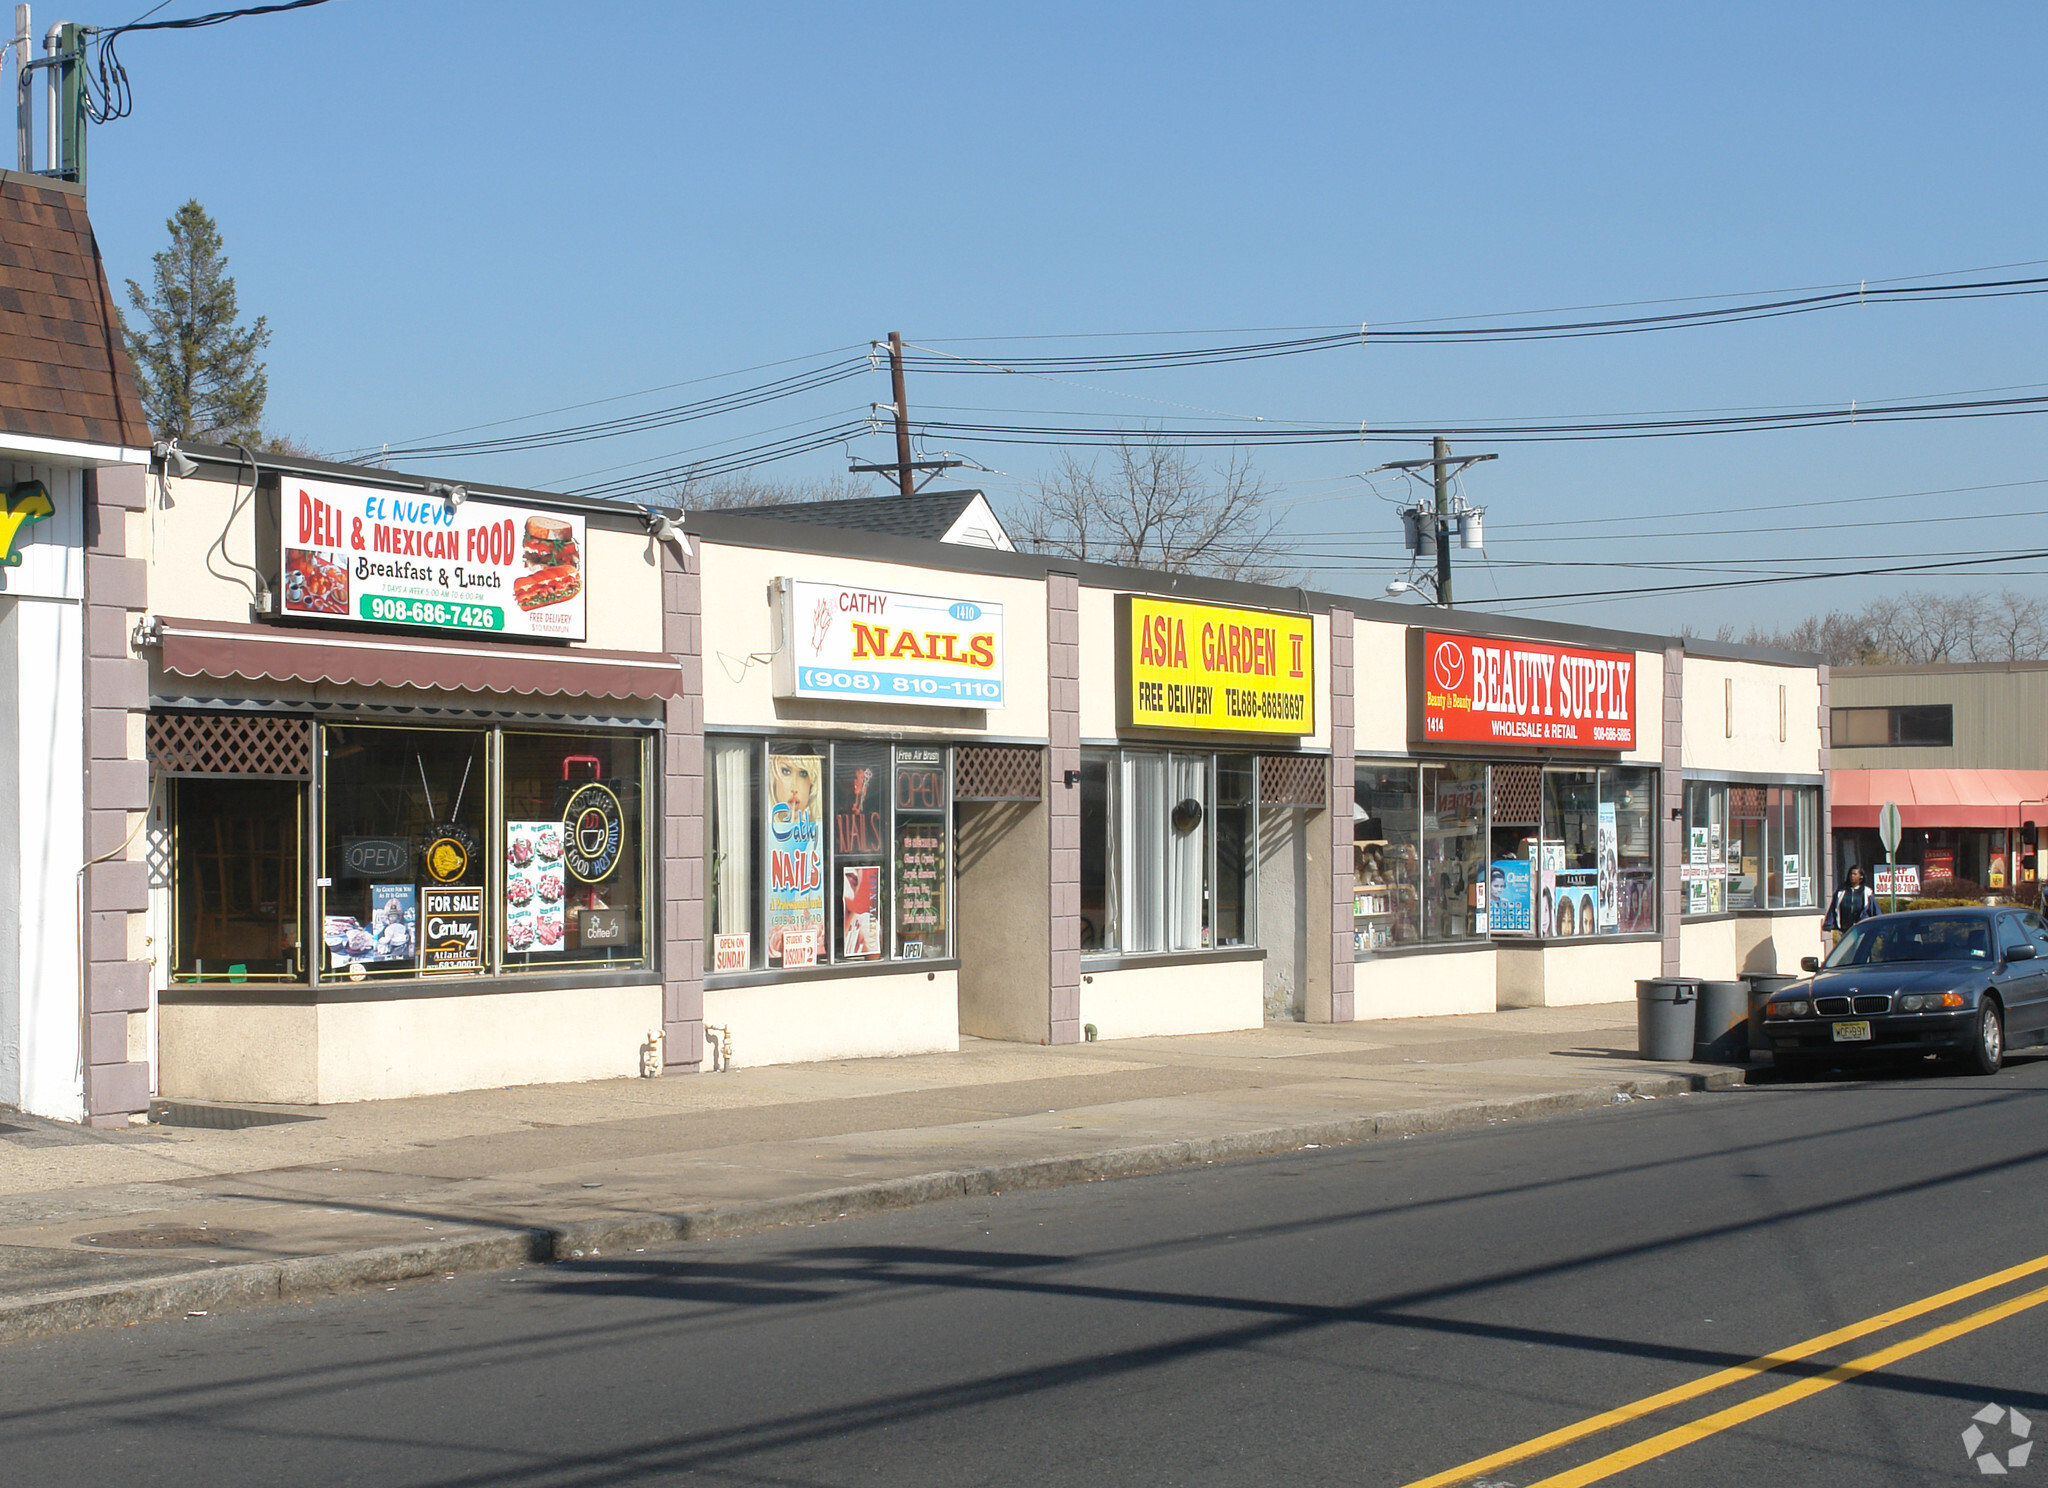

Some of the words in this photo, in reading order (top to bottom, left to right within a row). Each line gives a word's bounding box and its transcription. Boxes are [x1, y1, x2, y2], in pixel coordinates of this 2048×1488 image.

[365, 497, 387, 520] EL
[393, 499, 455, 527] NUEVO
[299, 489, 342, 548] DELI
[350, 516, 366, 550] &
[373, 523, 459, 560] MEXICAN
[467, 519, 515, 566] FOOD
[355, 556, 433, 581] Breakfast
[438, 568, 449, 589] &
[454, 567, 501, 589] Lunch
[387, 584, 402, 593] DAYS
[409, 586, 424, 596] WEEK
[440, 589, 450, 598] AM
[475, 592, 484, 601] PM
[839, 591, 887, 615] CATHY
[371, 598, 494, 628] 908-686-7426
[529, 612, 544, 622] FREE
[545, 613, 572, 624] DELIVERY
[955, 604, 975, 621] 1410
[851, 621, 995, 669] NAILS
[1140, 615, 1188, 668] ASIA
[1202, 622, 1276, 677] GARDEN
[1289, 633, 1304, 678] II
[804, 669, 881, 691] (908)
[892, 677, 1000, 698] 810-1110
[1471, 646, 1555, 716] BEAUTY
[1559, 654, 1631, 721] SUPPLY
[1139, 681, 1164, 712] FREE
[1167, 683, 1213, 715] DELIVERY
[1426, 691, 1446, 711] Beauty
[1452, 693, 1471, 712] Beauty
[1426, 717, 1444, 732] 1414
[1491, 720, 1542, 738] WHOLESALE
[1544, 723, 1550, 738] &
[1551, 723, 1578, 740] RETAIL
[898, 750, 912, 760] Free
[913, 750, 922, 760] Air
[898, 771, 943, 808] OPEN
[771, 803, 819, 850] Cathy
[836, 811, 881, 853] NAILS
[351, 848, 399, 868] OPEN
[1878, 874, 1915, 883] WANTED
[427, 895, 451, 912] FOR
[453, 895, 479, 912] SALE
[427, 917, 472, 939] Century
[587, 928, 611, 939] Coffee
[465, 929, 478, 951] 21
[719, 938, 735, 949] OPEN
[736, 937, 744, 948] ON
[785, 935, 803, 944] STUDENT
[433, 950, 471, 959] Atlantic
[717, 950, 746, 969] SUNDAY
[905, 943, 922, 958] OPEN
